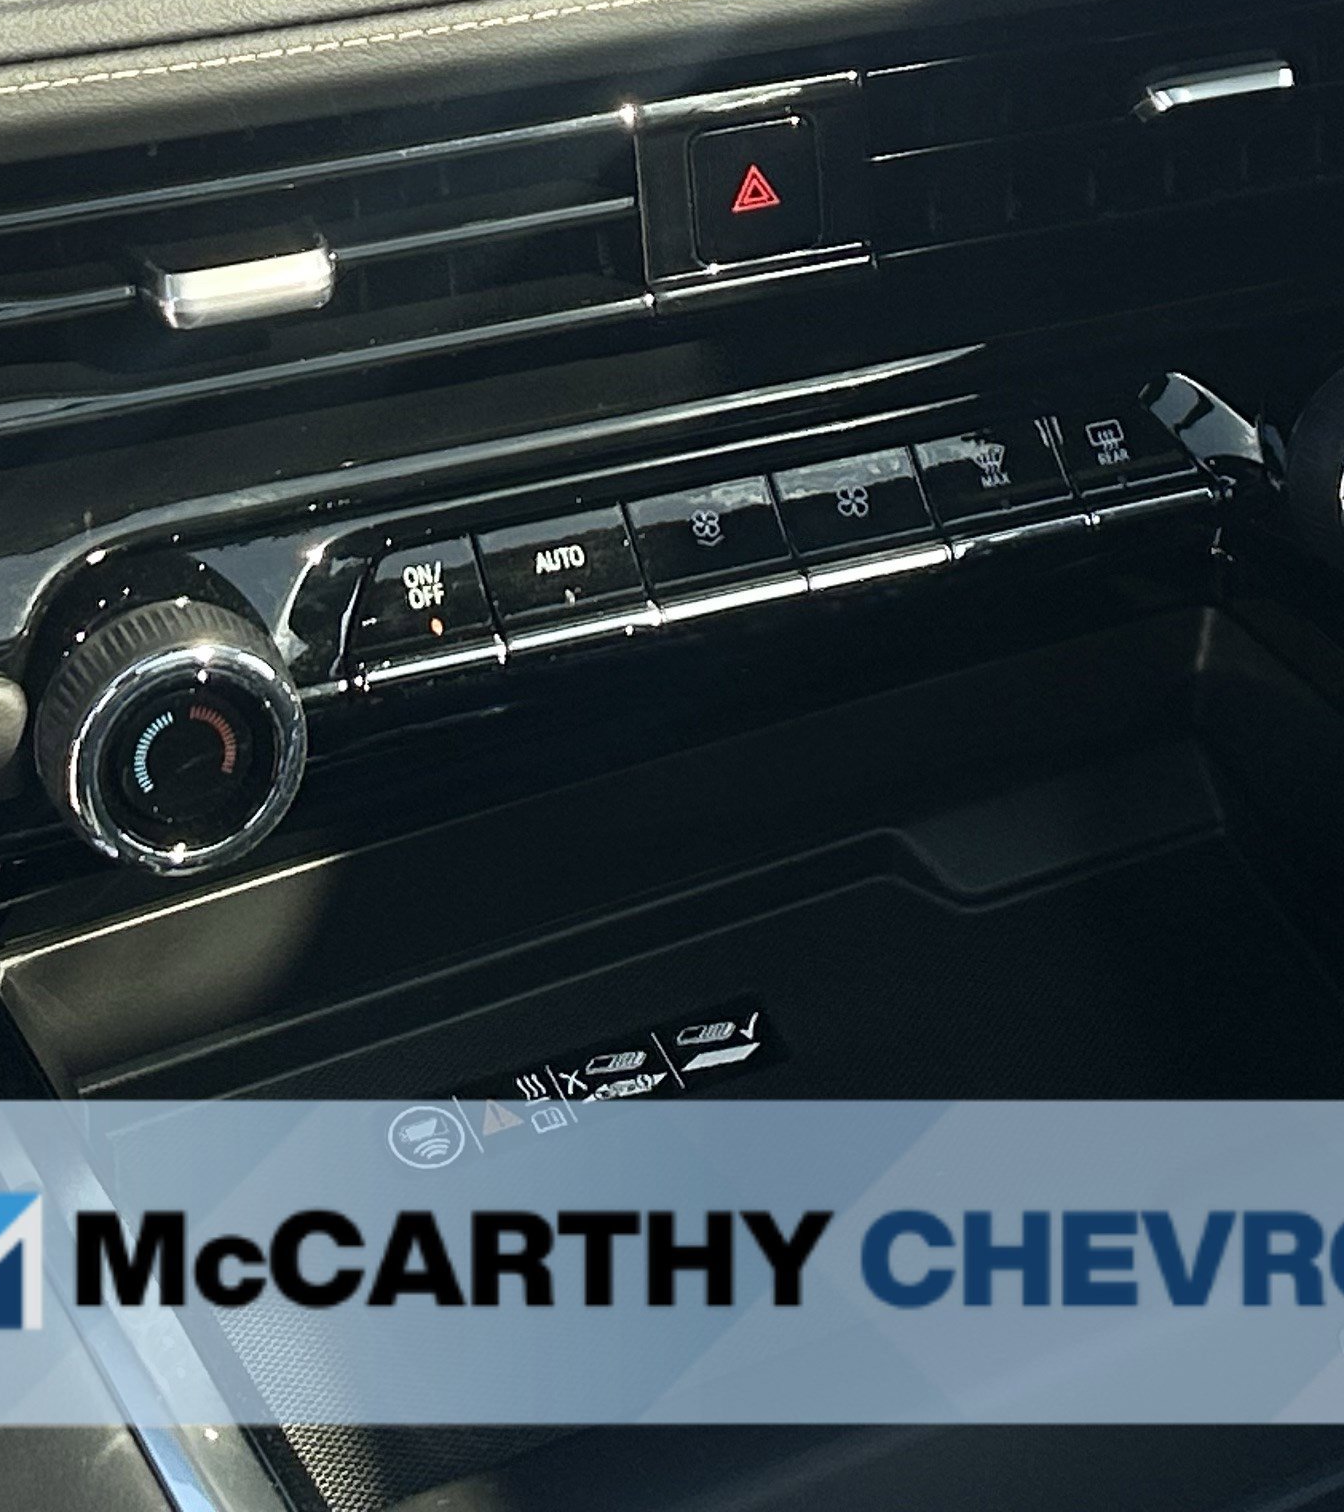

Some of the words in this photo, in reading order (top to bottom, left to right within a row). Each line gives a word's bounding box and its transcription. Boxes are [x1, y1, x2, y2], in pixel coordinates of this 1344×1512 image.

[981, 472, 1011, 488] MAX
[535, 545, 585, 574] AUTO
[403, 560, 442, 588] ON/
[408, 583, 444, 609] OFF
